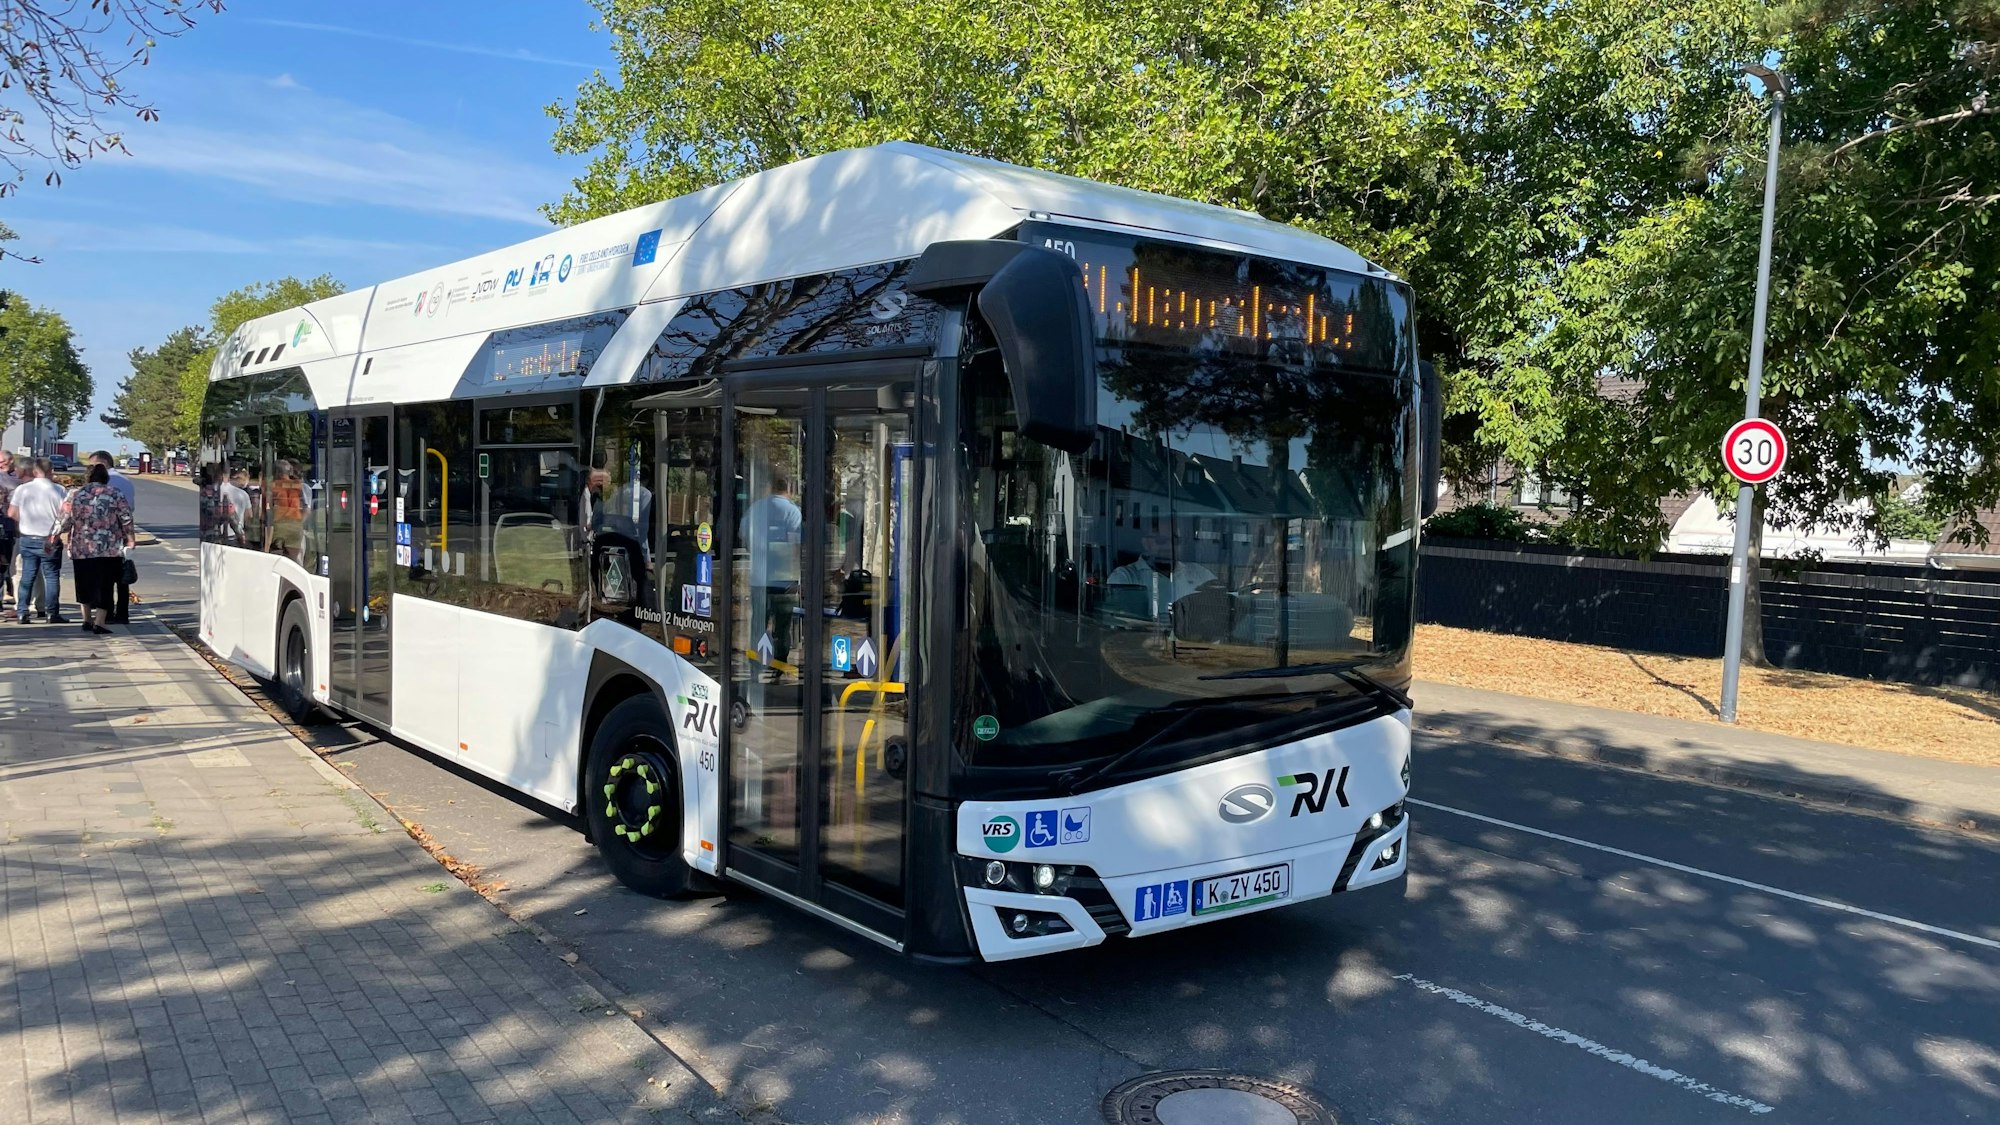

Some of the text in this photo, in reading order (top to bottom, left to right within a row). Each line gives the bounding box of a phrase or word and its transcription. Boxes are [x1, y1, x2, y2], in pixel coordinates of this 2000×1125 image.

[865, 323, 902, 335] SOLARIS
[1738, 438, 1772, 466] 30
[634, 606, 661, 623] Urbino
[672, 612, 714, 634] hydrogen
[699, 750, 715, 772] 450
[1276, 765, 1350, 818] RVK
[982, 823, 1012, 836] VRS
[1209, 870, 1281, 905] K ZY 450
